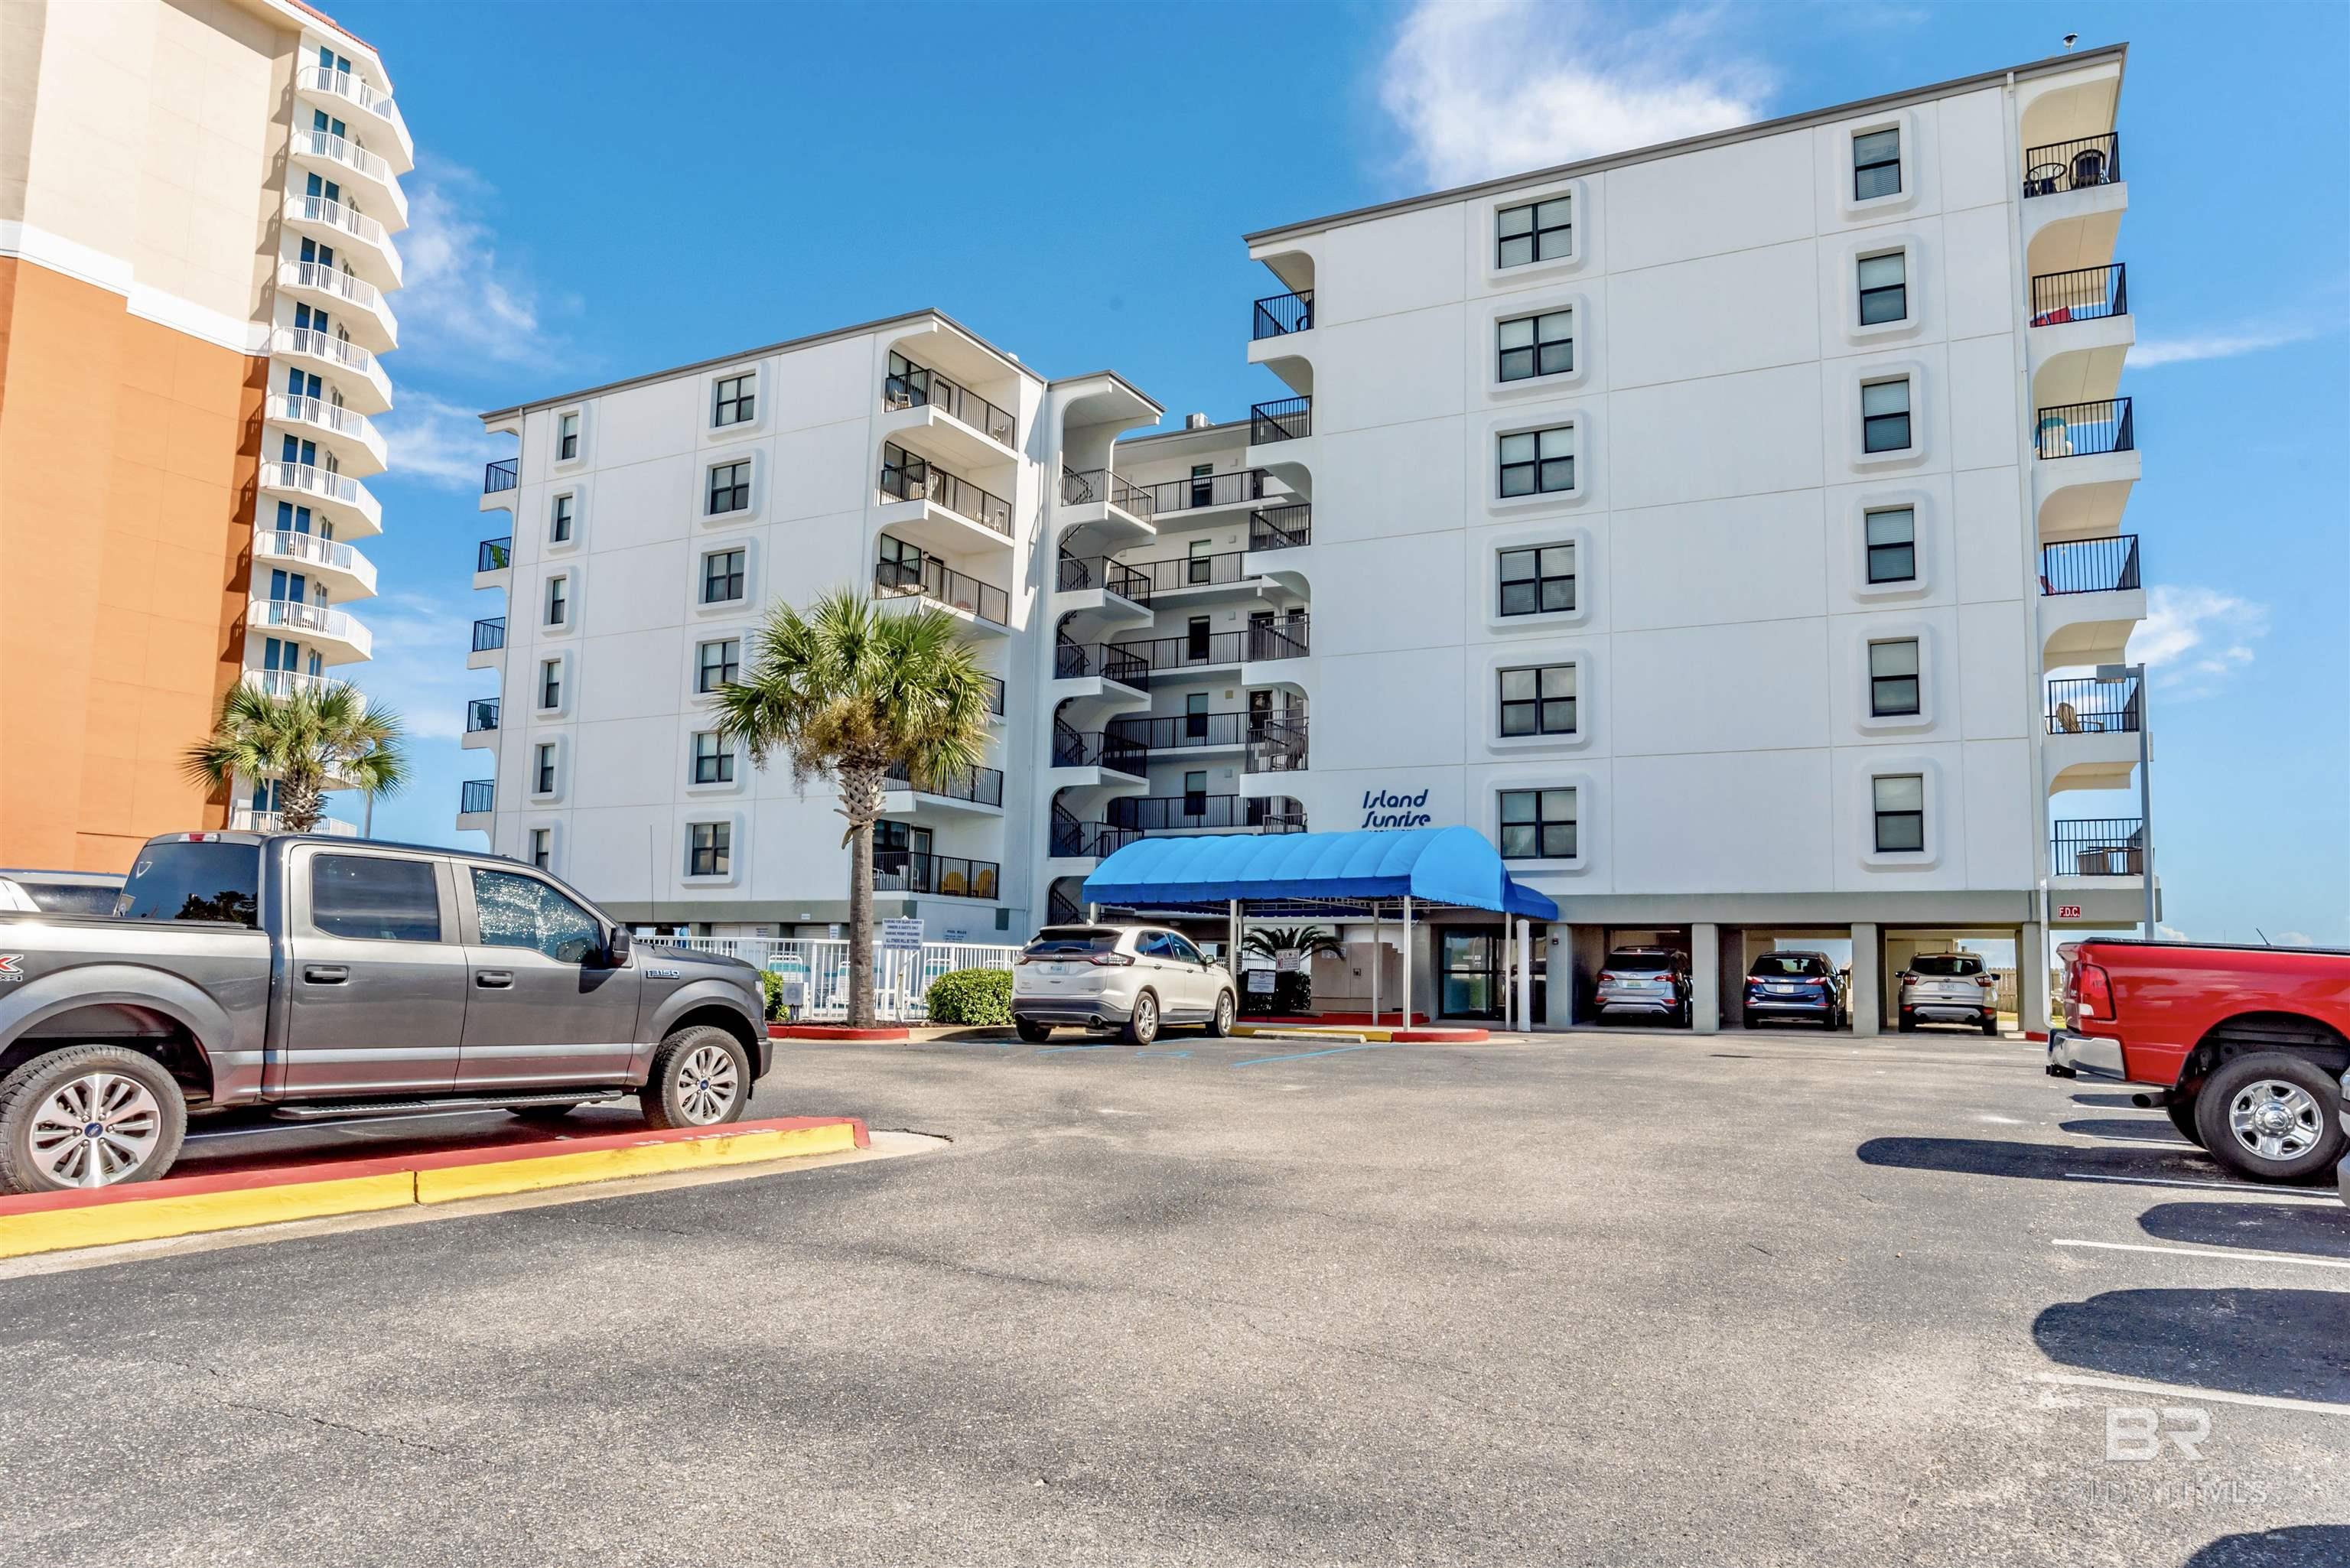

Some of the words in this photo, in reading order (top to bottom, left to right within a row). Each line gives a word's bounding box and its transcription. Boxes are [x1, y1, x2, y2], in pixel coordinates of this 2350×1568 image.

[1362, 789, 1429, 809] Island
[1362, 810, 1431, 828] Sunrise
[2059, 907, 2080, 916] F.D.C.
